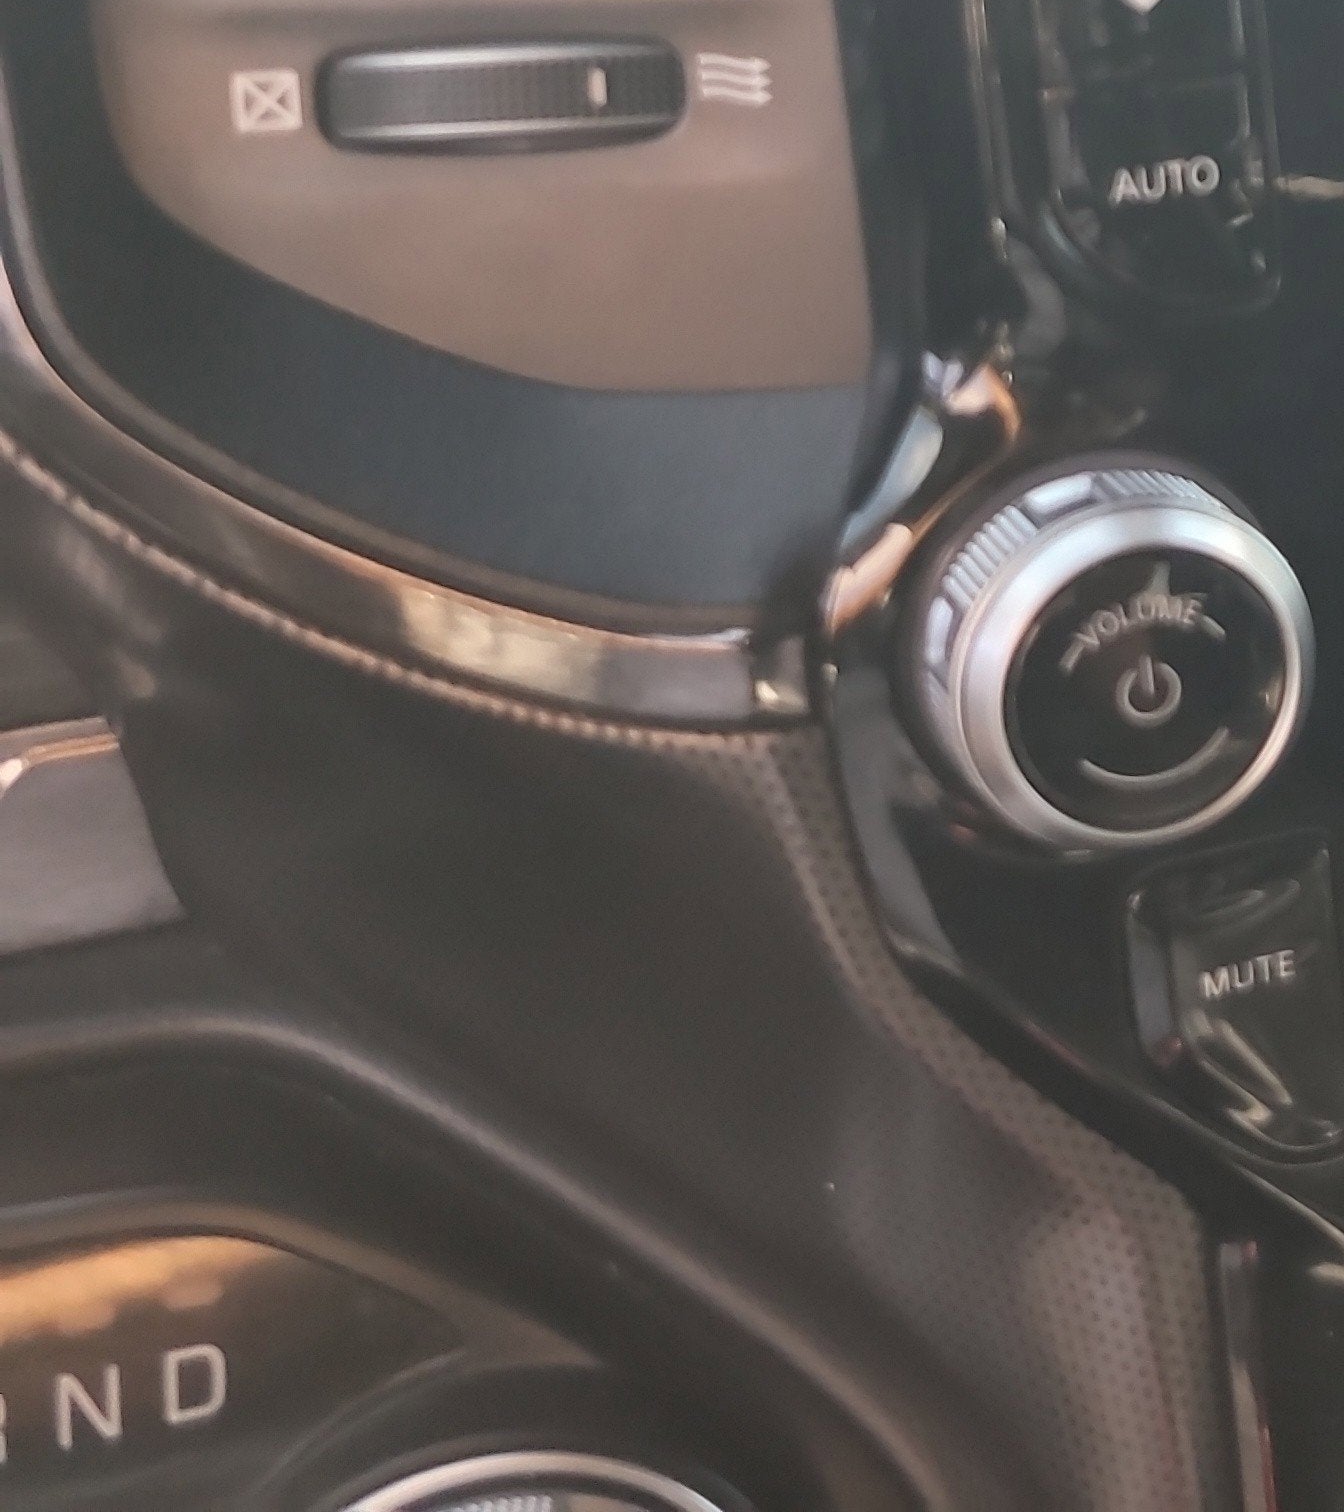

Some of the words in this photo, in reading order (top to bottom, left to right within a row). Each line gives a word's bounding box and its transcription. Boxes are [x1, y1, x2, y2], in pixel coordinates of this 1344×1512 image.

[1108, 155, 1220, 208] AUTO
[1075, 595, 1203, 648] VOLUME
[1200, 949, 1296, 998] MUTE
